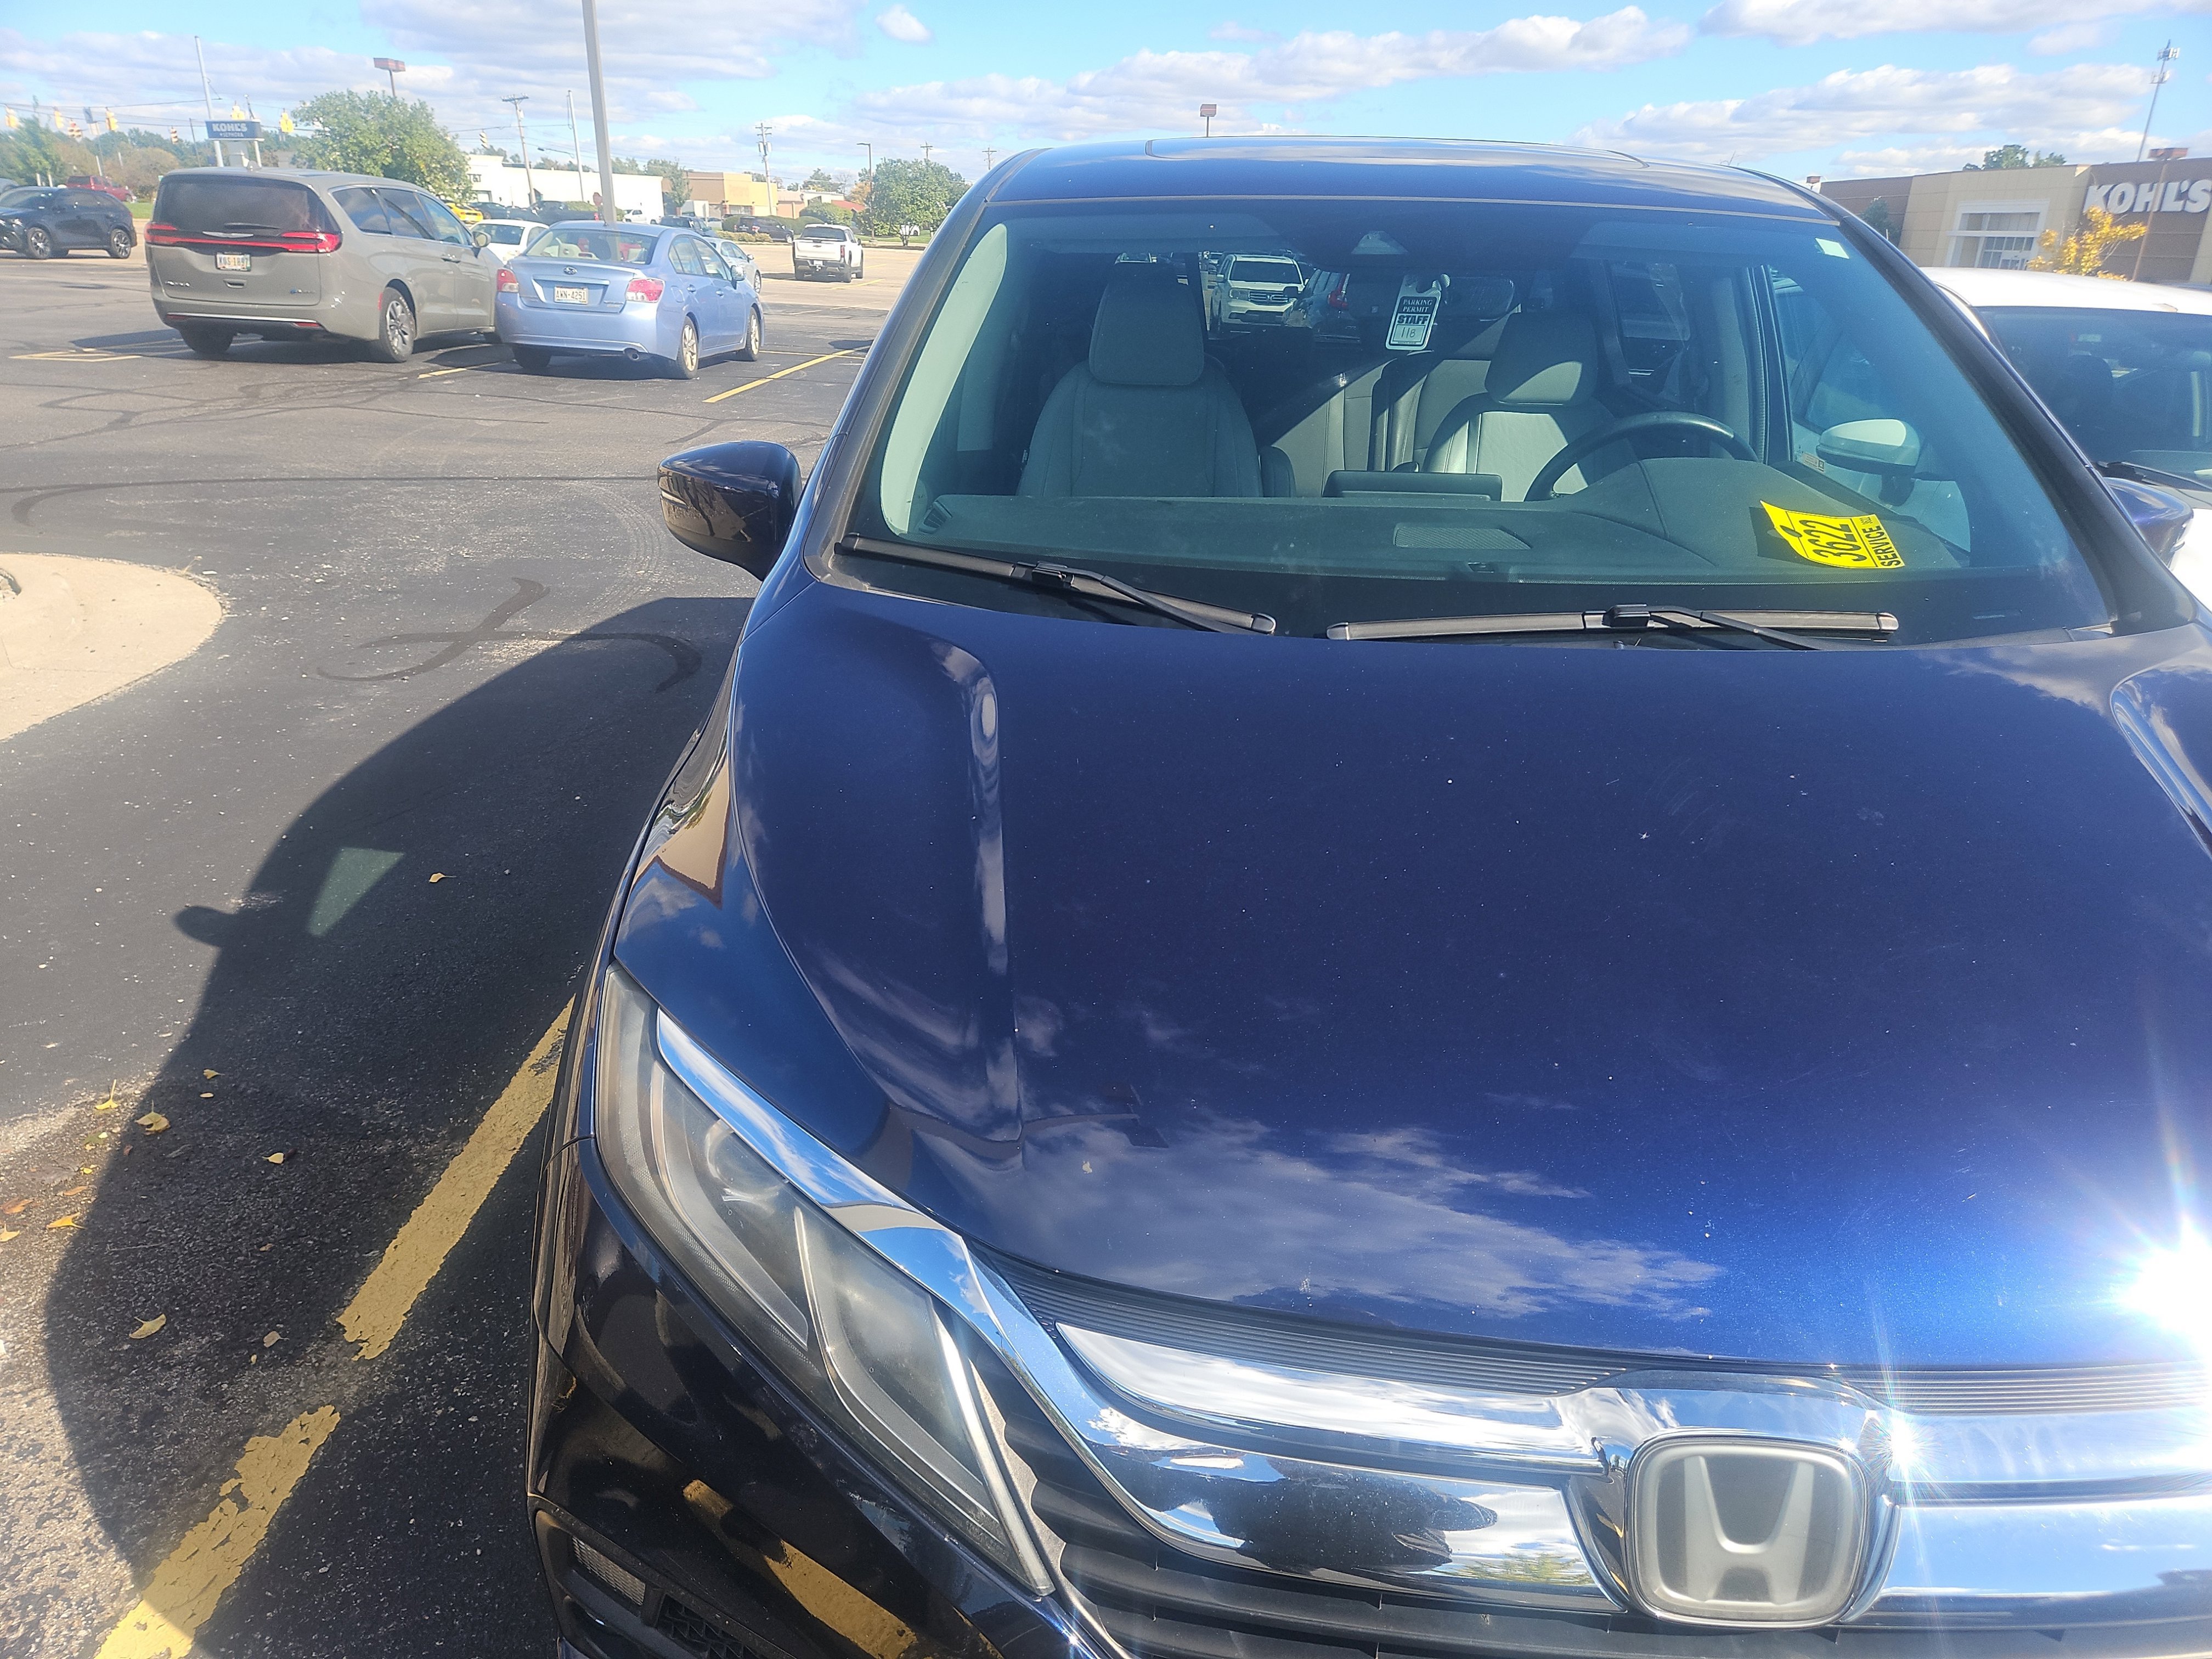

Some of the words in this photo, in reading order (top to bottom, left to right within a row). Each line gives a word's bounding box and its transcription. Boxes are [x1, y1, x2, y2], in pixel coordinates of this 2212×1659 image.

[212, 123, 248, 132] KOHL'S
[2083, 179, 2212, 214] KOHL'S
[1397, 315, 1429, 324] STAFF
[1798, 520, 1867, 562] 3622
[1861, 525, 1901, 567] SERVICE
